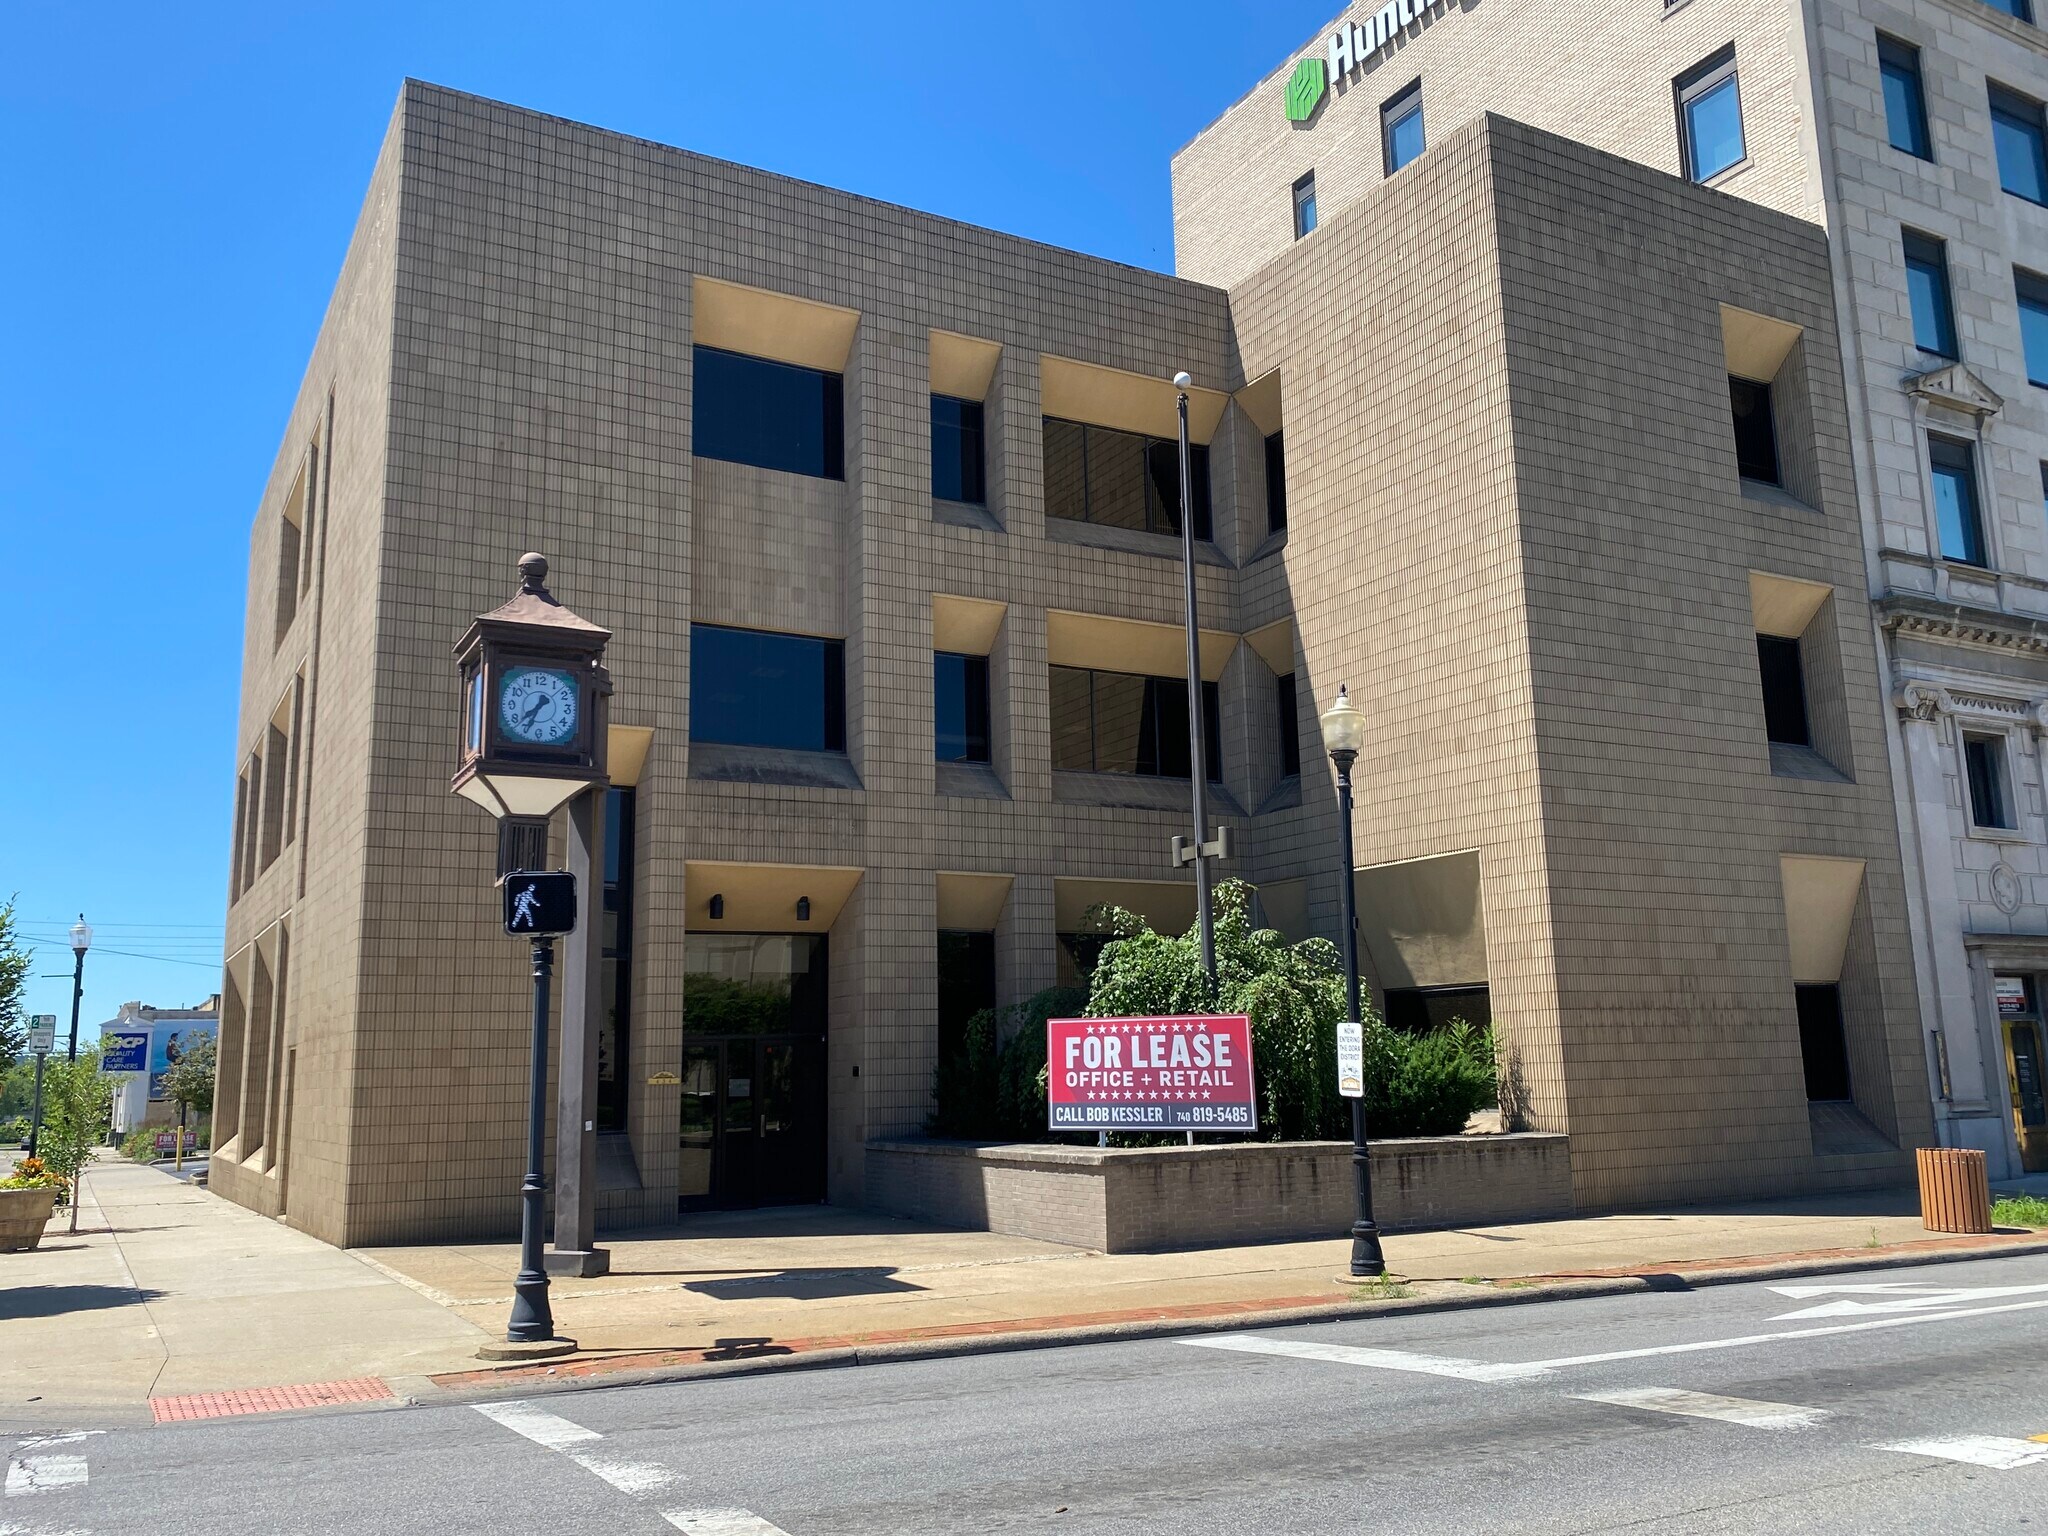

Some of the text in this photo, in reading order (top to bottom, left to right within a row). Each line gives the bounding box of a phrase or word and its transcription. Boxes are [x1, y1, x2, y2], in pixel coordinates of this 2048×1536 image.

[523, 678, 531, 688] 11
[535, 676, 547, 686] 12
[512, 687, 523, 697] 10
[561, 690, 568, 700] 2
[508, 699, 516, 710] 9
[563, 704, 572, 715] 3
[511, 713, 519, 724] 8
[559, 717, 568, 727] 4
[534, 728, 543, 739] 6
[549, 726, 557, 737] 5
[32, 1017, 39, 1027] 2
[1065, 1033, 1233, 1069] FOR LEASE
[1065, 1070, 1234, 1087] OFFICE + RETAIL
[1055, 1107, 1248, 1122] CALL BOB KESSLER 740 819-5485
[173, 1134, 194, 1142] LASE
